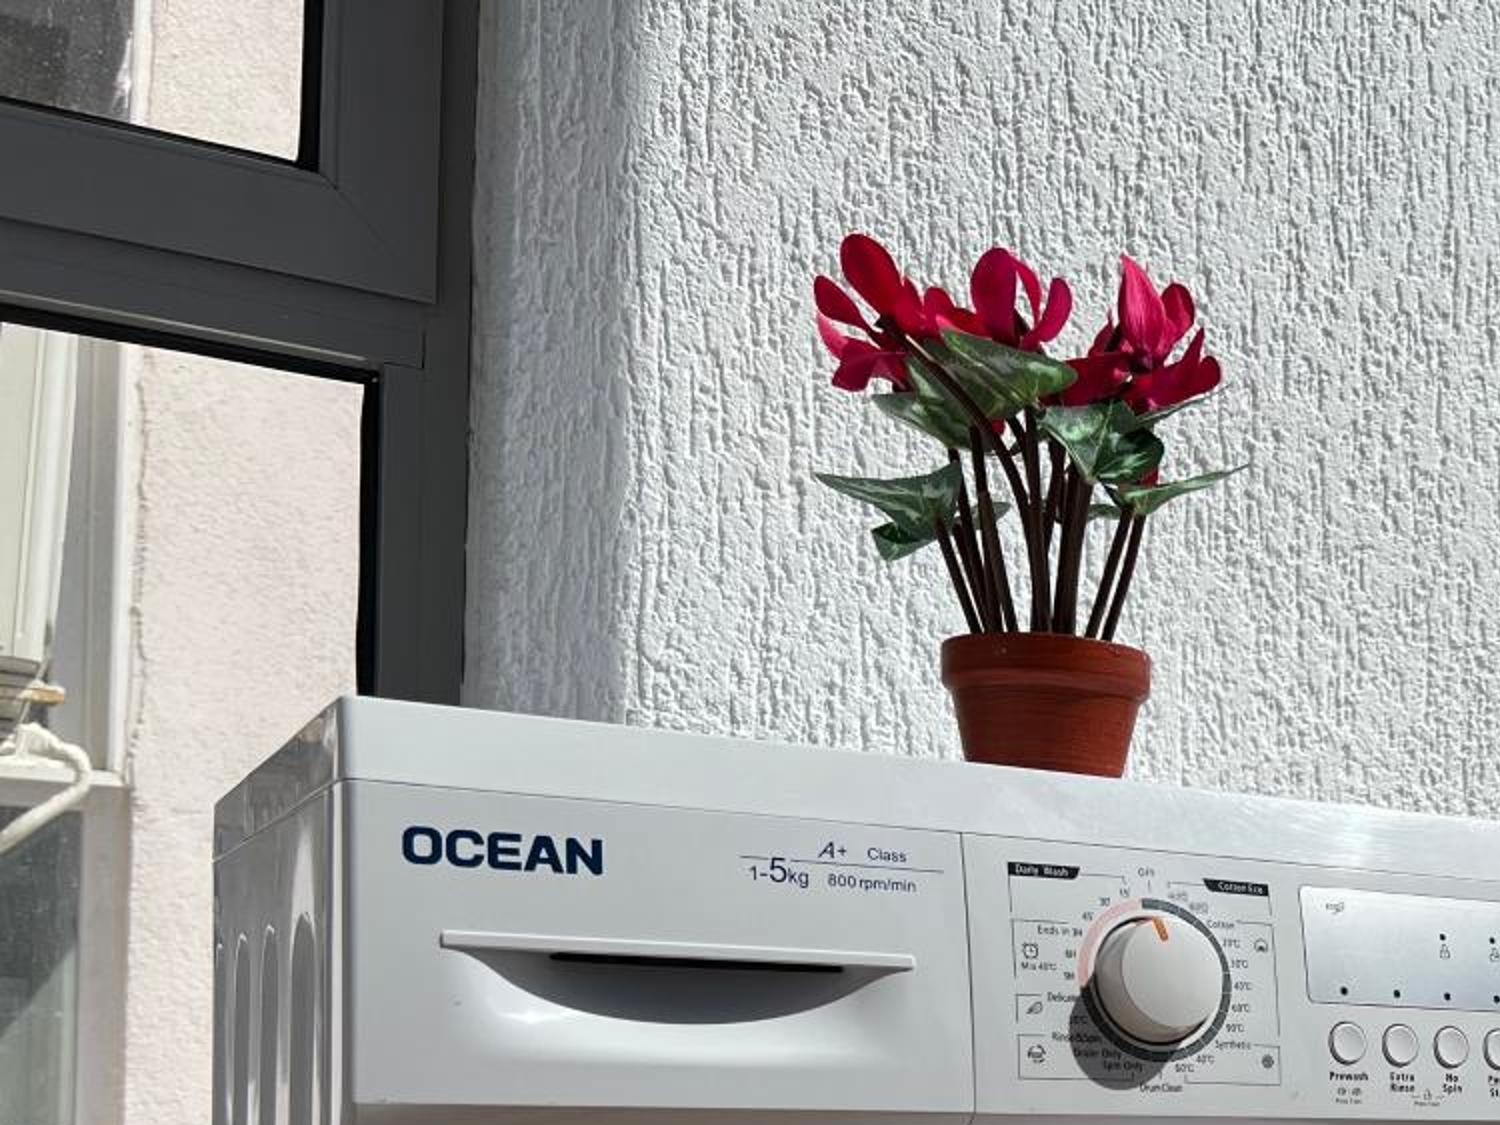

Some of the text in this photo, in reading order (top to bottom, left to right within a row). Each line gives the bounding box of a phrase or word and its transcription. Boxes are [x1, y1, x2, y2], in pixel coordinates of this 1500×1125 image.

[402, 826, 603, 876] OCEAN
[867, 847, 907, 863] Class
[750, 857, 809, 889] 1-5kg
[1014, 863, 1069, 877] Daily Wash
[828, 873, 917, 893] 800 rpm/min
[1329, 1071, 1369, 1082] Prewash
[1389, 1071, 1416, 1082] Extra
[1445, 1072, 1460, 1083] No
[1390, 1082, 1416, 1093] Rinse
[1443, 1084, 1463, 1096] Spin
